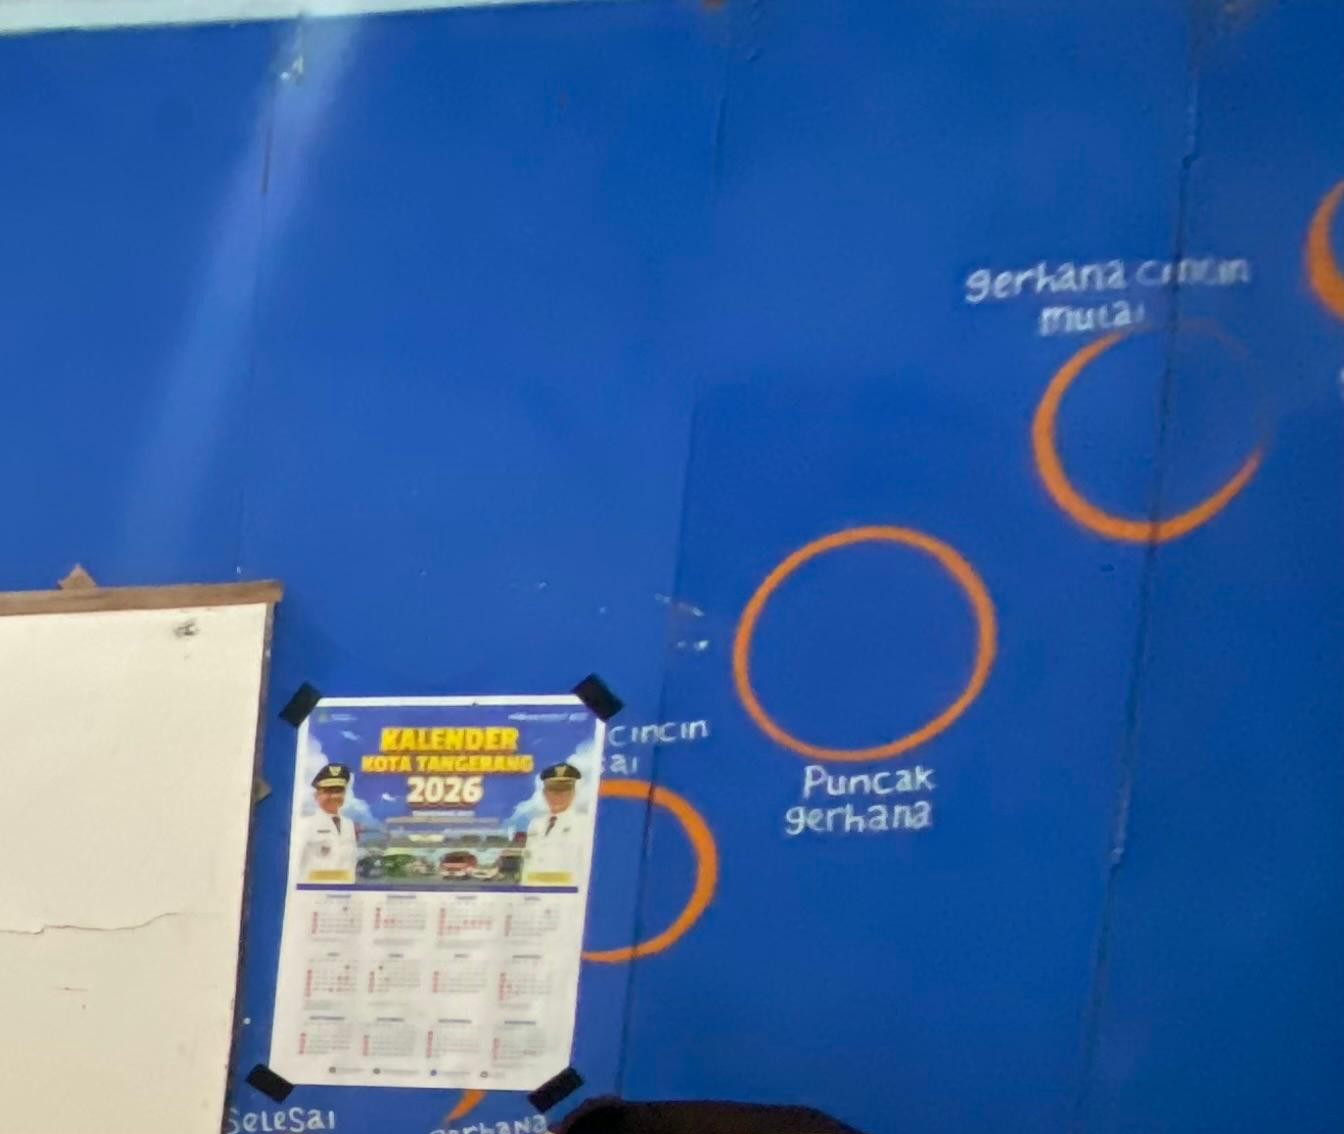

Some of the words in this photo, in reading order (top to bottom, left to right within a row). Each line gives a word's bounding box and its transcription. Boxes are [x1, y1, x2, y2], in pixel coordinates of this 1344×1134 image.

[966, 259, 1127, 303] gerhana
[380, 727, 519, 752] KALENDER
[608, 719, 710, 748] cincin
[361, 756, 413, 773] KOTA
[416, 755, 535, 774] TANGERANG
[406, 775, 484, 804] 2026
[802, 764, 936, 799] Puncak
[784, 800, 932, 837] gerhana
